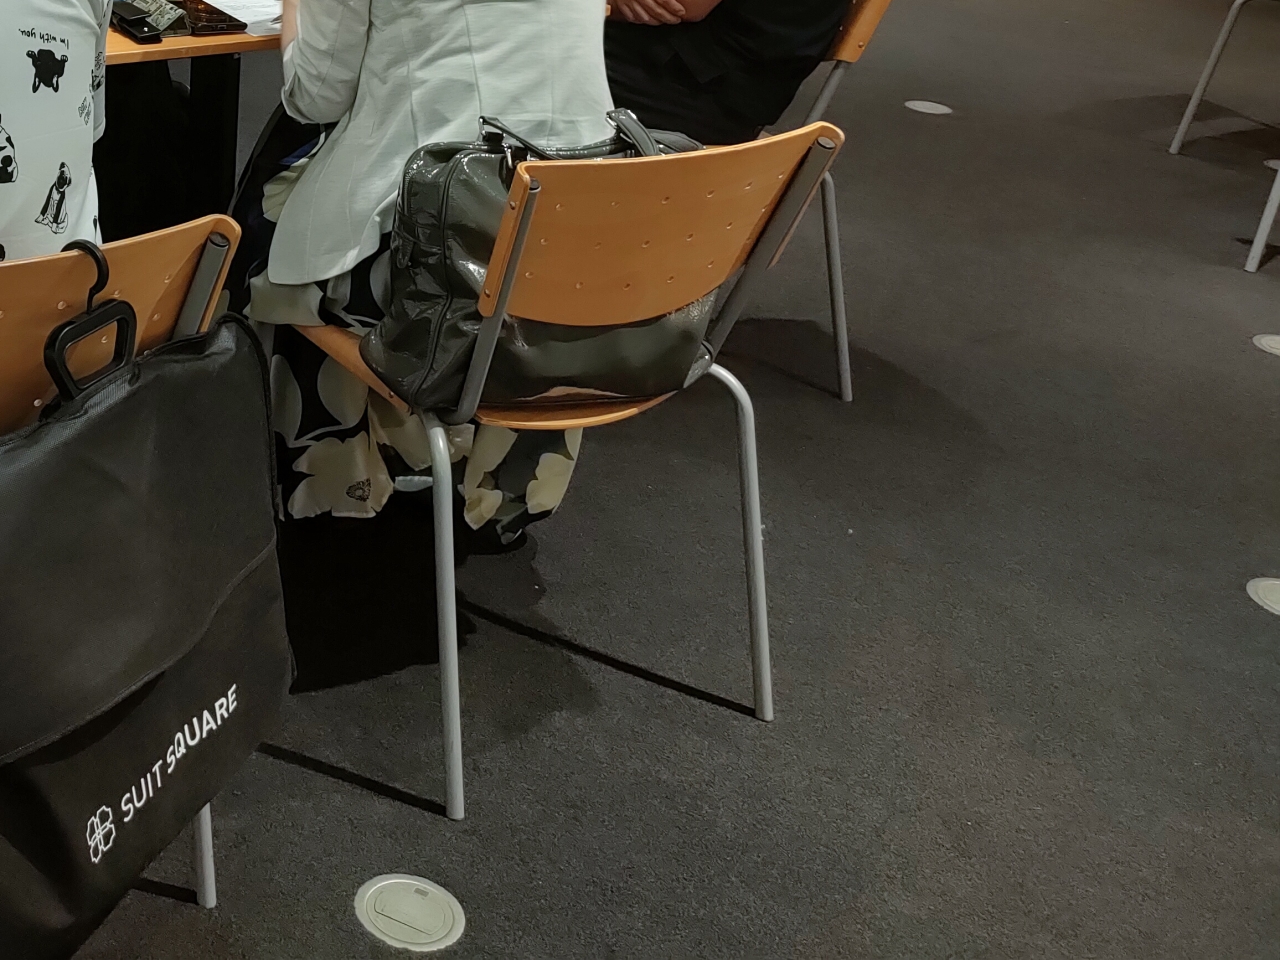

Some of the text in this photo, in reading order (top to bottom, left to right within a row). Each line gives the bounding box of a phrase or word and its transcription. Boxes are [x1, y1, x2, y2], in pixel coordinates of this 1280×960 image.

[39, 32, 57, 44] with
[120, 683, 238, 824] SUIT SQUARE
